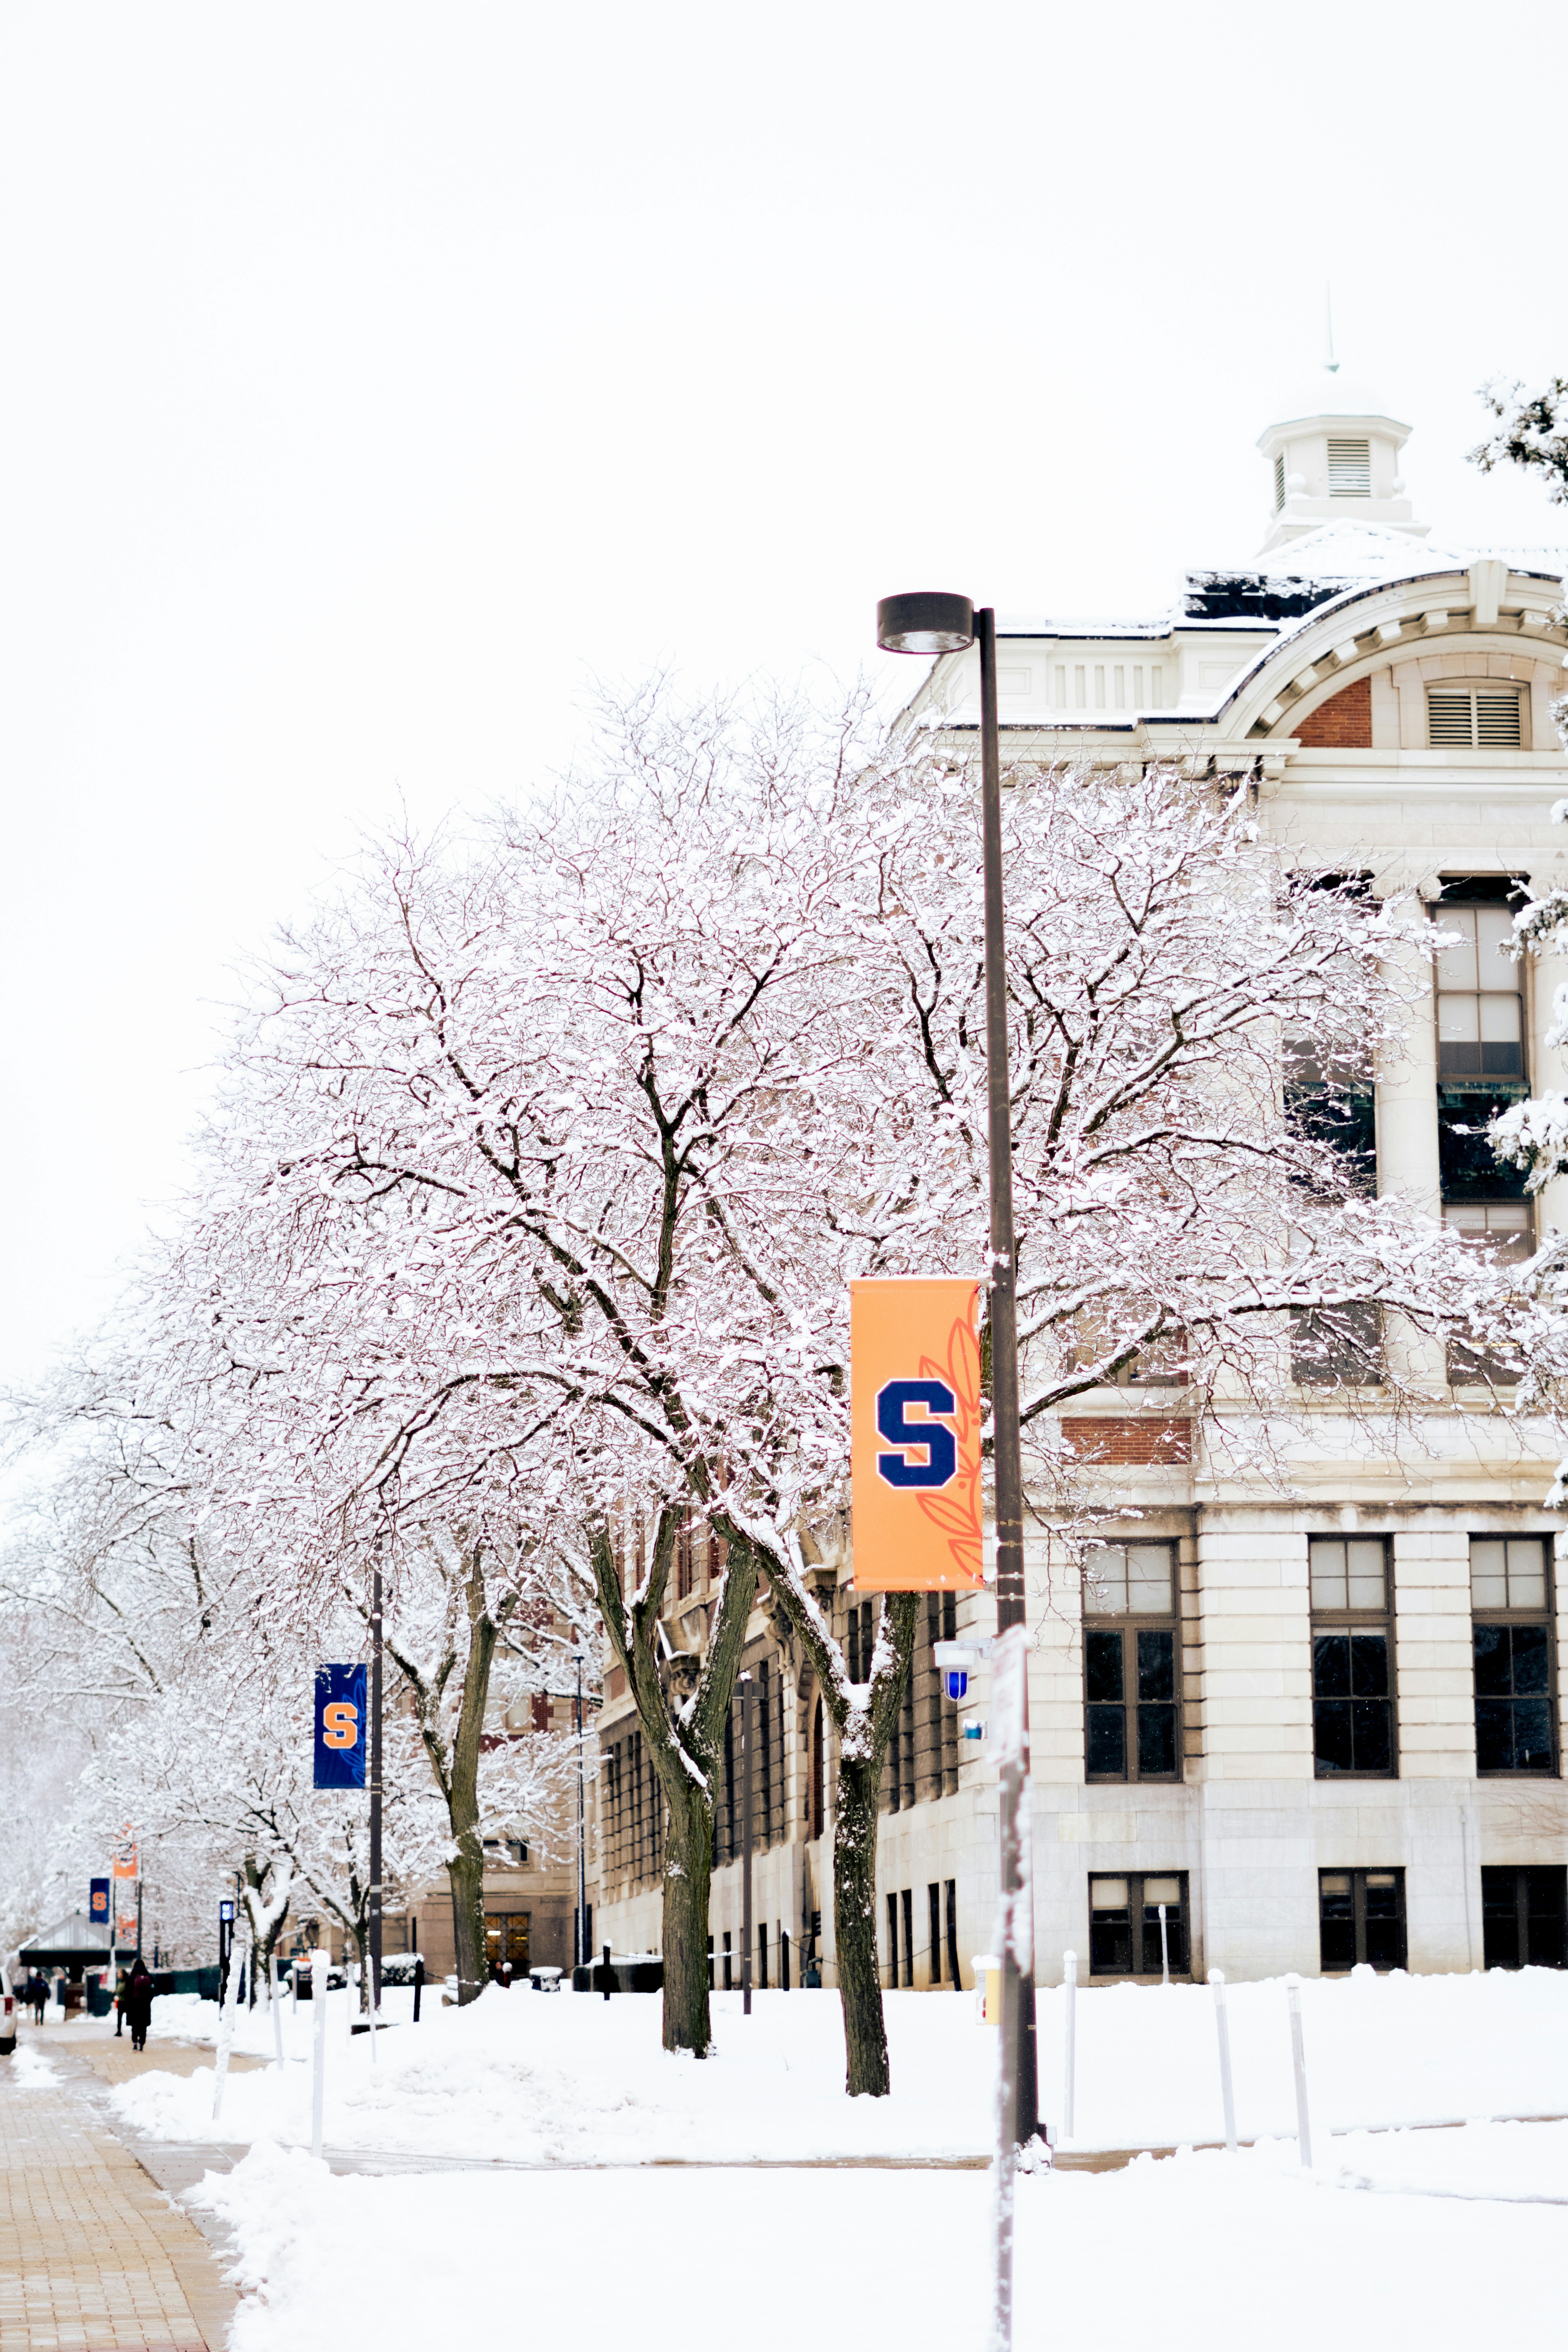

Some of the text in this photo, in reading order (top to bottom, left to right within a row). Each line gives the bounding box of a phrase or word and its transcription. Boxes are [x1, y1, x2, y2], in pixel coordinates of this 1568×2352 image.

[875, 1378, 958, 1489] S
[323, 1702, 358, 1749] S
[92, 1892, 106, 1911] S
